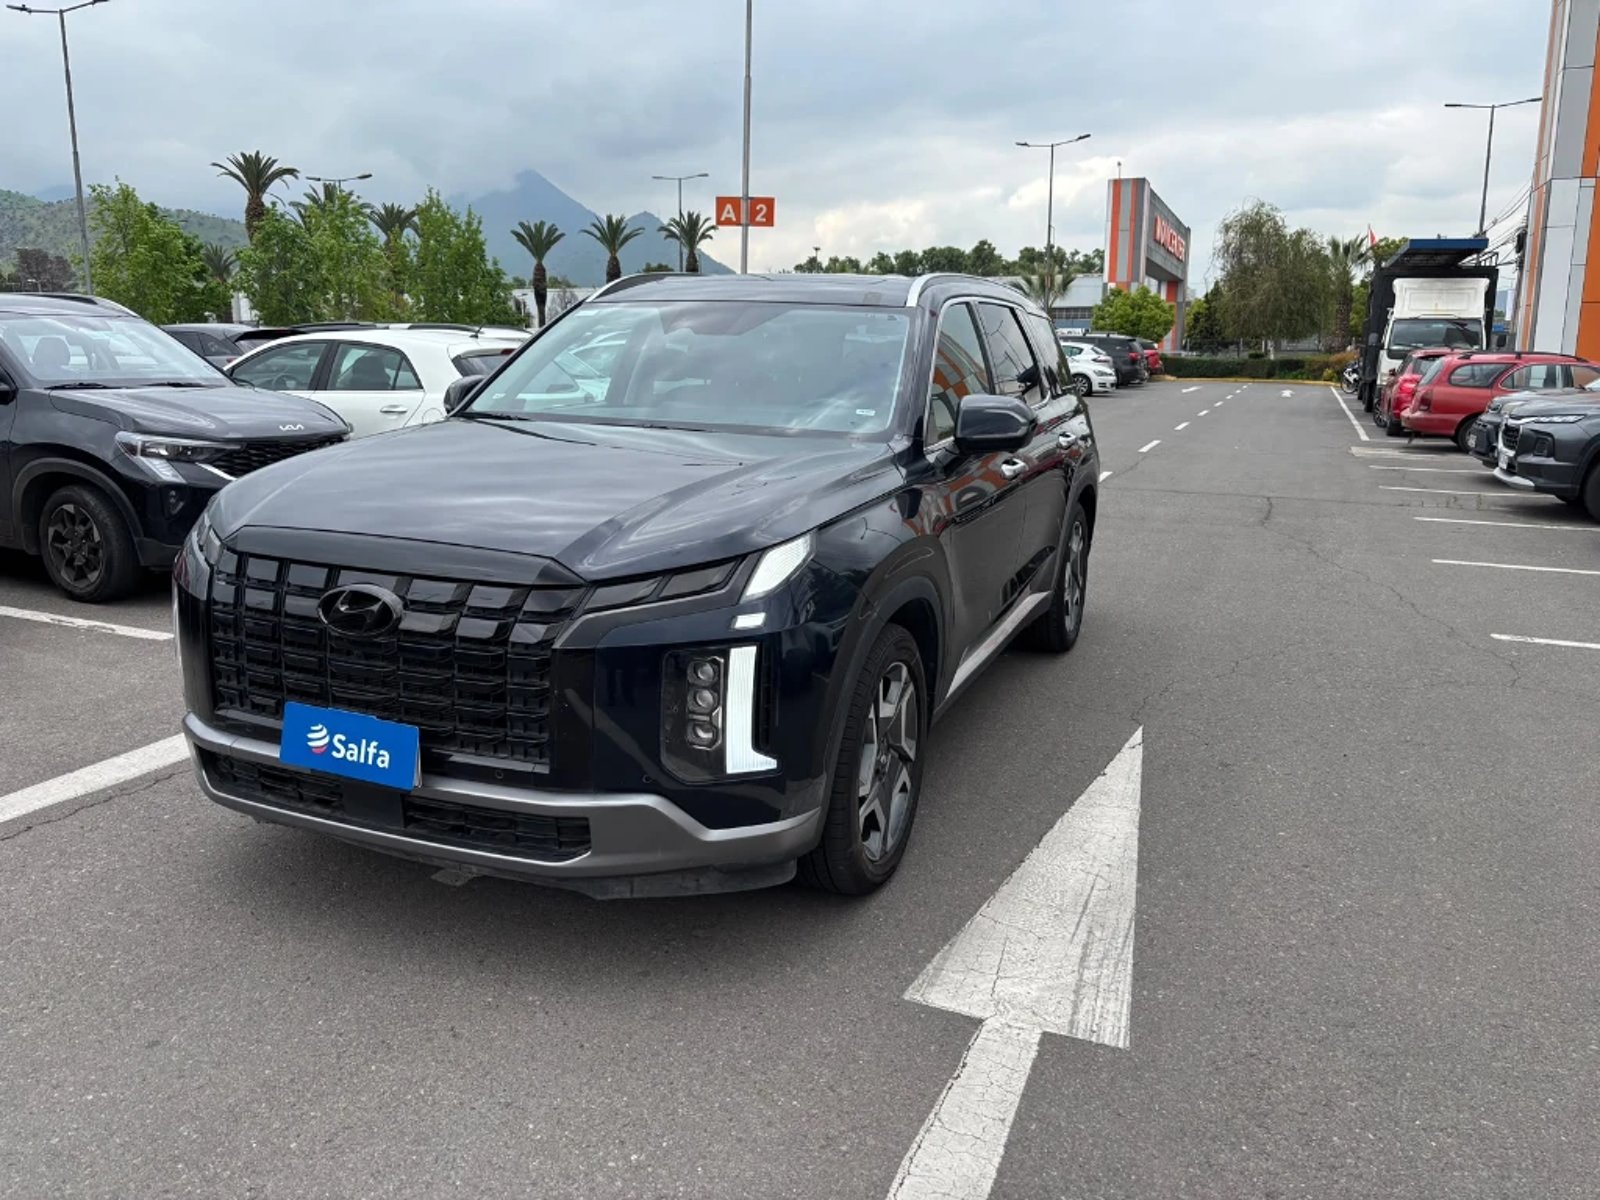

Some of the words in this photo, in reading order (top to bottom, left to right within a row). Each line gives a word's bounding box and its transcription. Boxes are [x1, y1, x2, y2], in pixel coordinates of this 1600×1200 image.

[720, 203, 737, 222] A
[755, 203, 768, 223] 2
[331, 733, 391, 770] Salfa
